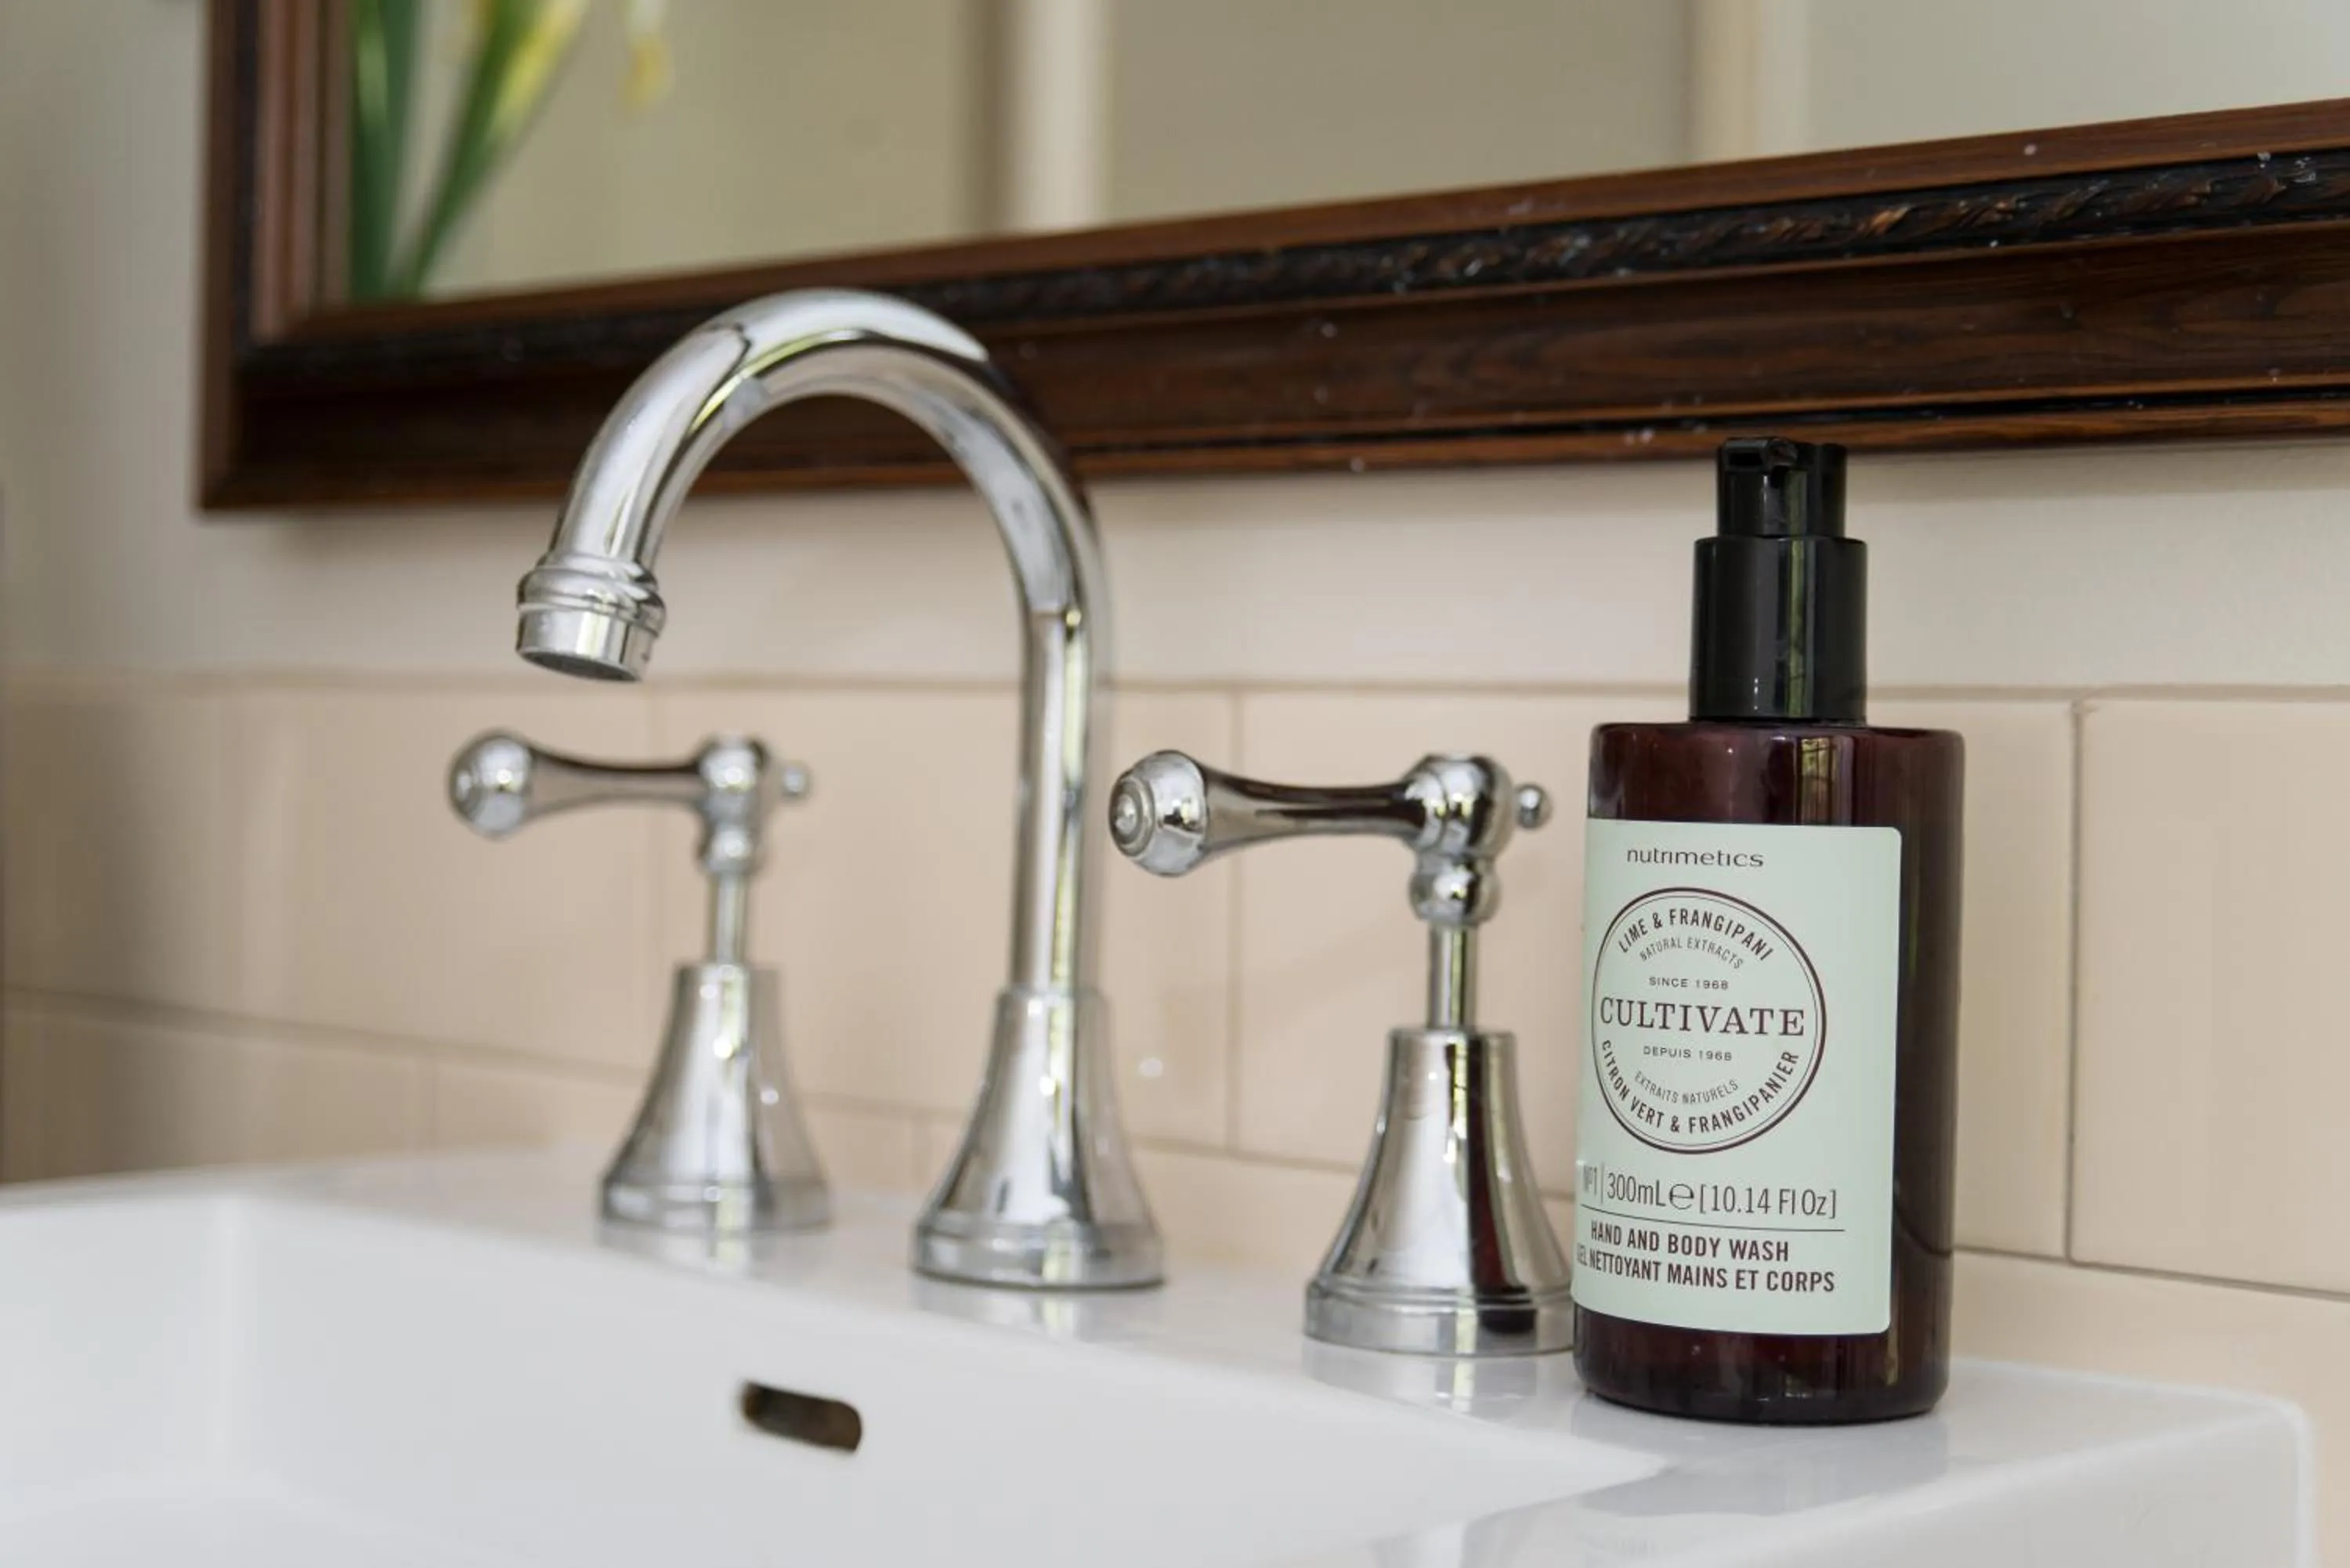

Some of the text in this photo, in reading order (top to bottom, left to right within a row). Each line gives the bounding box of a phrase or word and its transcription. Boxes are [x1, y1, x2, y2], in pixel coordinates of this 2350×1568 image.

[1627, 847, 1764, 868] nutrimetics
[1619, 908, 1773, 961] LIME & FRANGIPANI
[1640, 937, 1744, 970] NATURAL EXTRACTS
[1649, 977, 1729, 990] SINCE 1968
[1600, 997, 1805, 1036] CULTIVATE
[1643, 1046, 1733, 1061] DEPUIS 1968
[1602, 1039, 1799, 1134] CITRON VERT & FRANGIPANIER
[1635, 1071, 1739, 1104] EXTRAITS NATURELS
[1699, 1183, 1771, 1215] [10.14
[1591, 1220, 1789, 1262] HAND AND BODY WASH
[1589, 1248, 1661, 1282] NETTOYANT
[1667, 1263, 1727, 1288] MAINS
[1735, 1270, 1759, 1291] ET
[1766, 1271, 1835, 1292] CORPS
